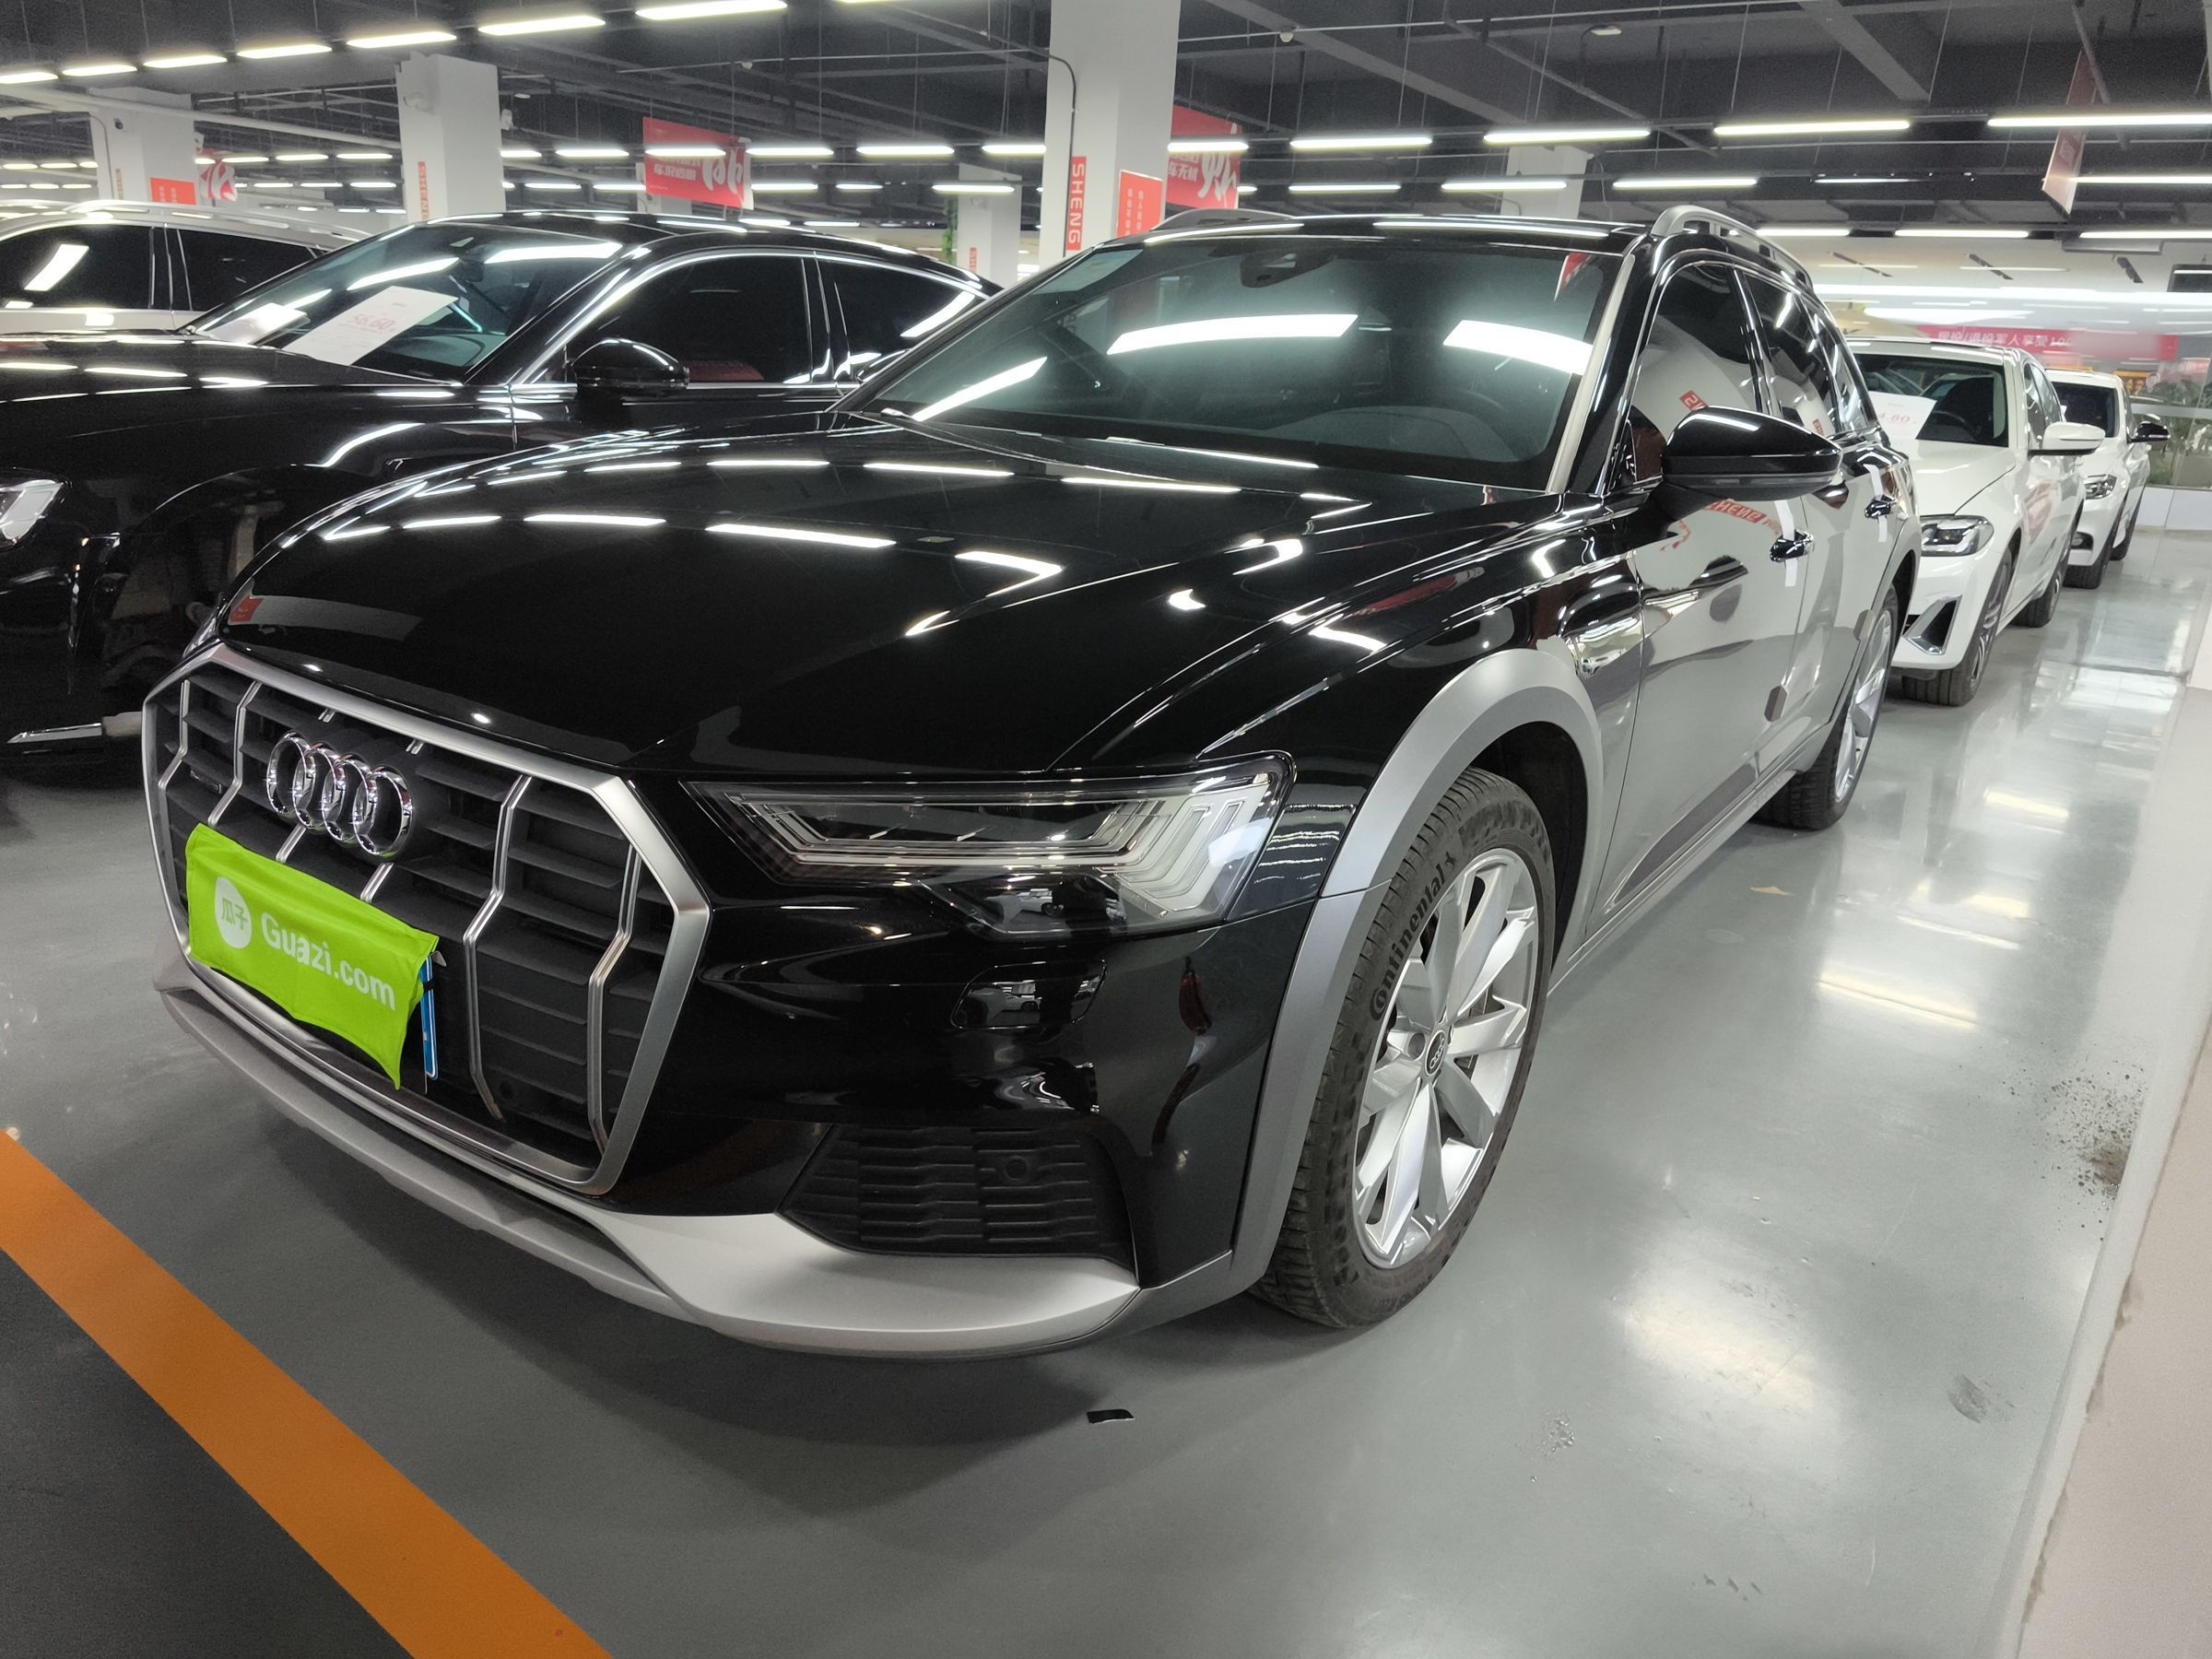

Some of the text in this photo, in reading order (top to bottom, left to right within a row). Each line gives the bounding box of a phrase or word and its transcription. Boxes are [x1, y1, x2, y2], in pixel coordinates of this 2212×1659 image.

[1068, 163, 1085, 243] SHENG
[221, 897, 248, 931] 瓜子
[1370, 863, 1446, 1021] Continental
[261, 912, 395, 1011] Guazi.com
